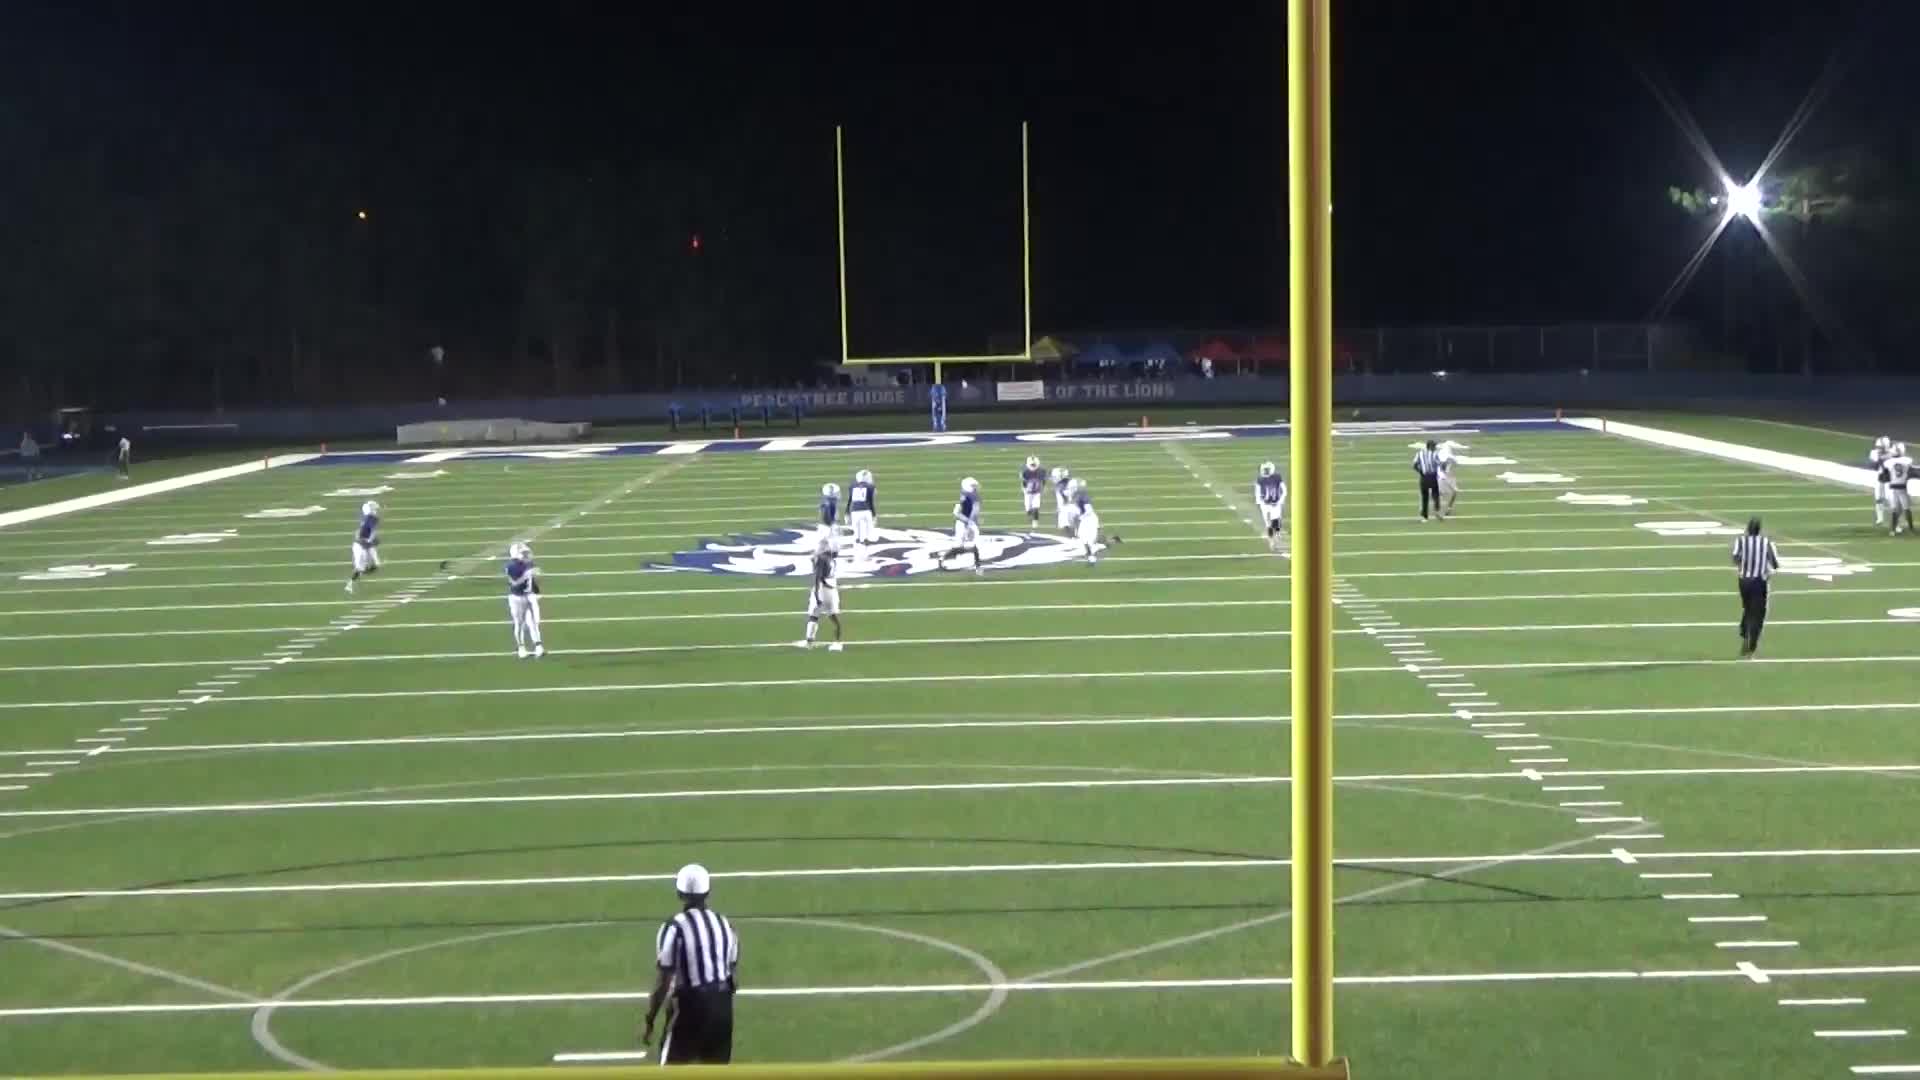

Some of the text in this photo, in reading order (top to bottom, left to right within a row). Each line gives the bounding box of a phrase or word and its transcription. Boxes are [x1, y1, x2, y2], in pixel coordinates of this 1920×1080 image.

[1055, 384, 1076, 398] OF
[1080, 384, 1118, 398] THE
[1124, 383, 1175, 398] LIONS
